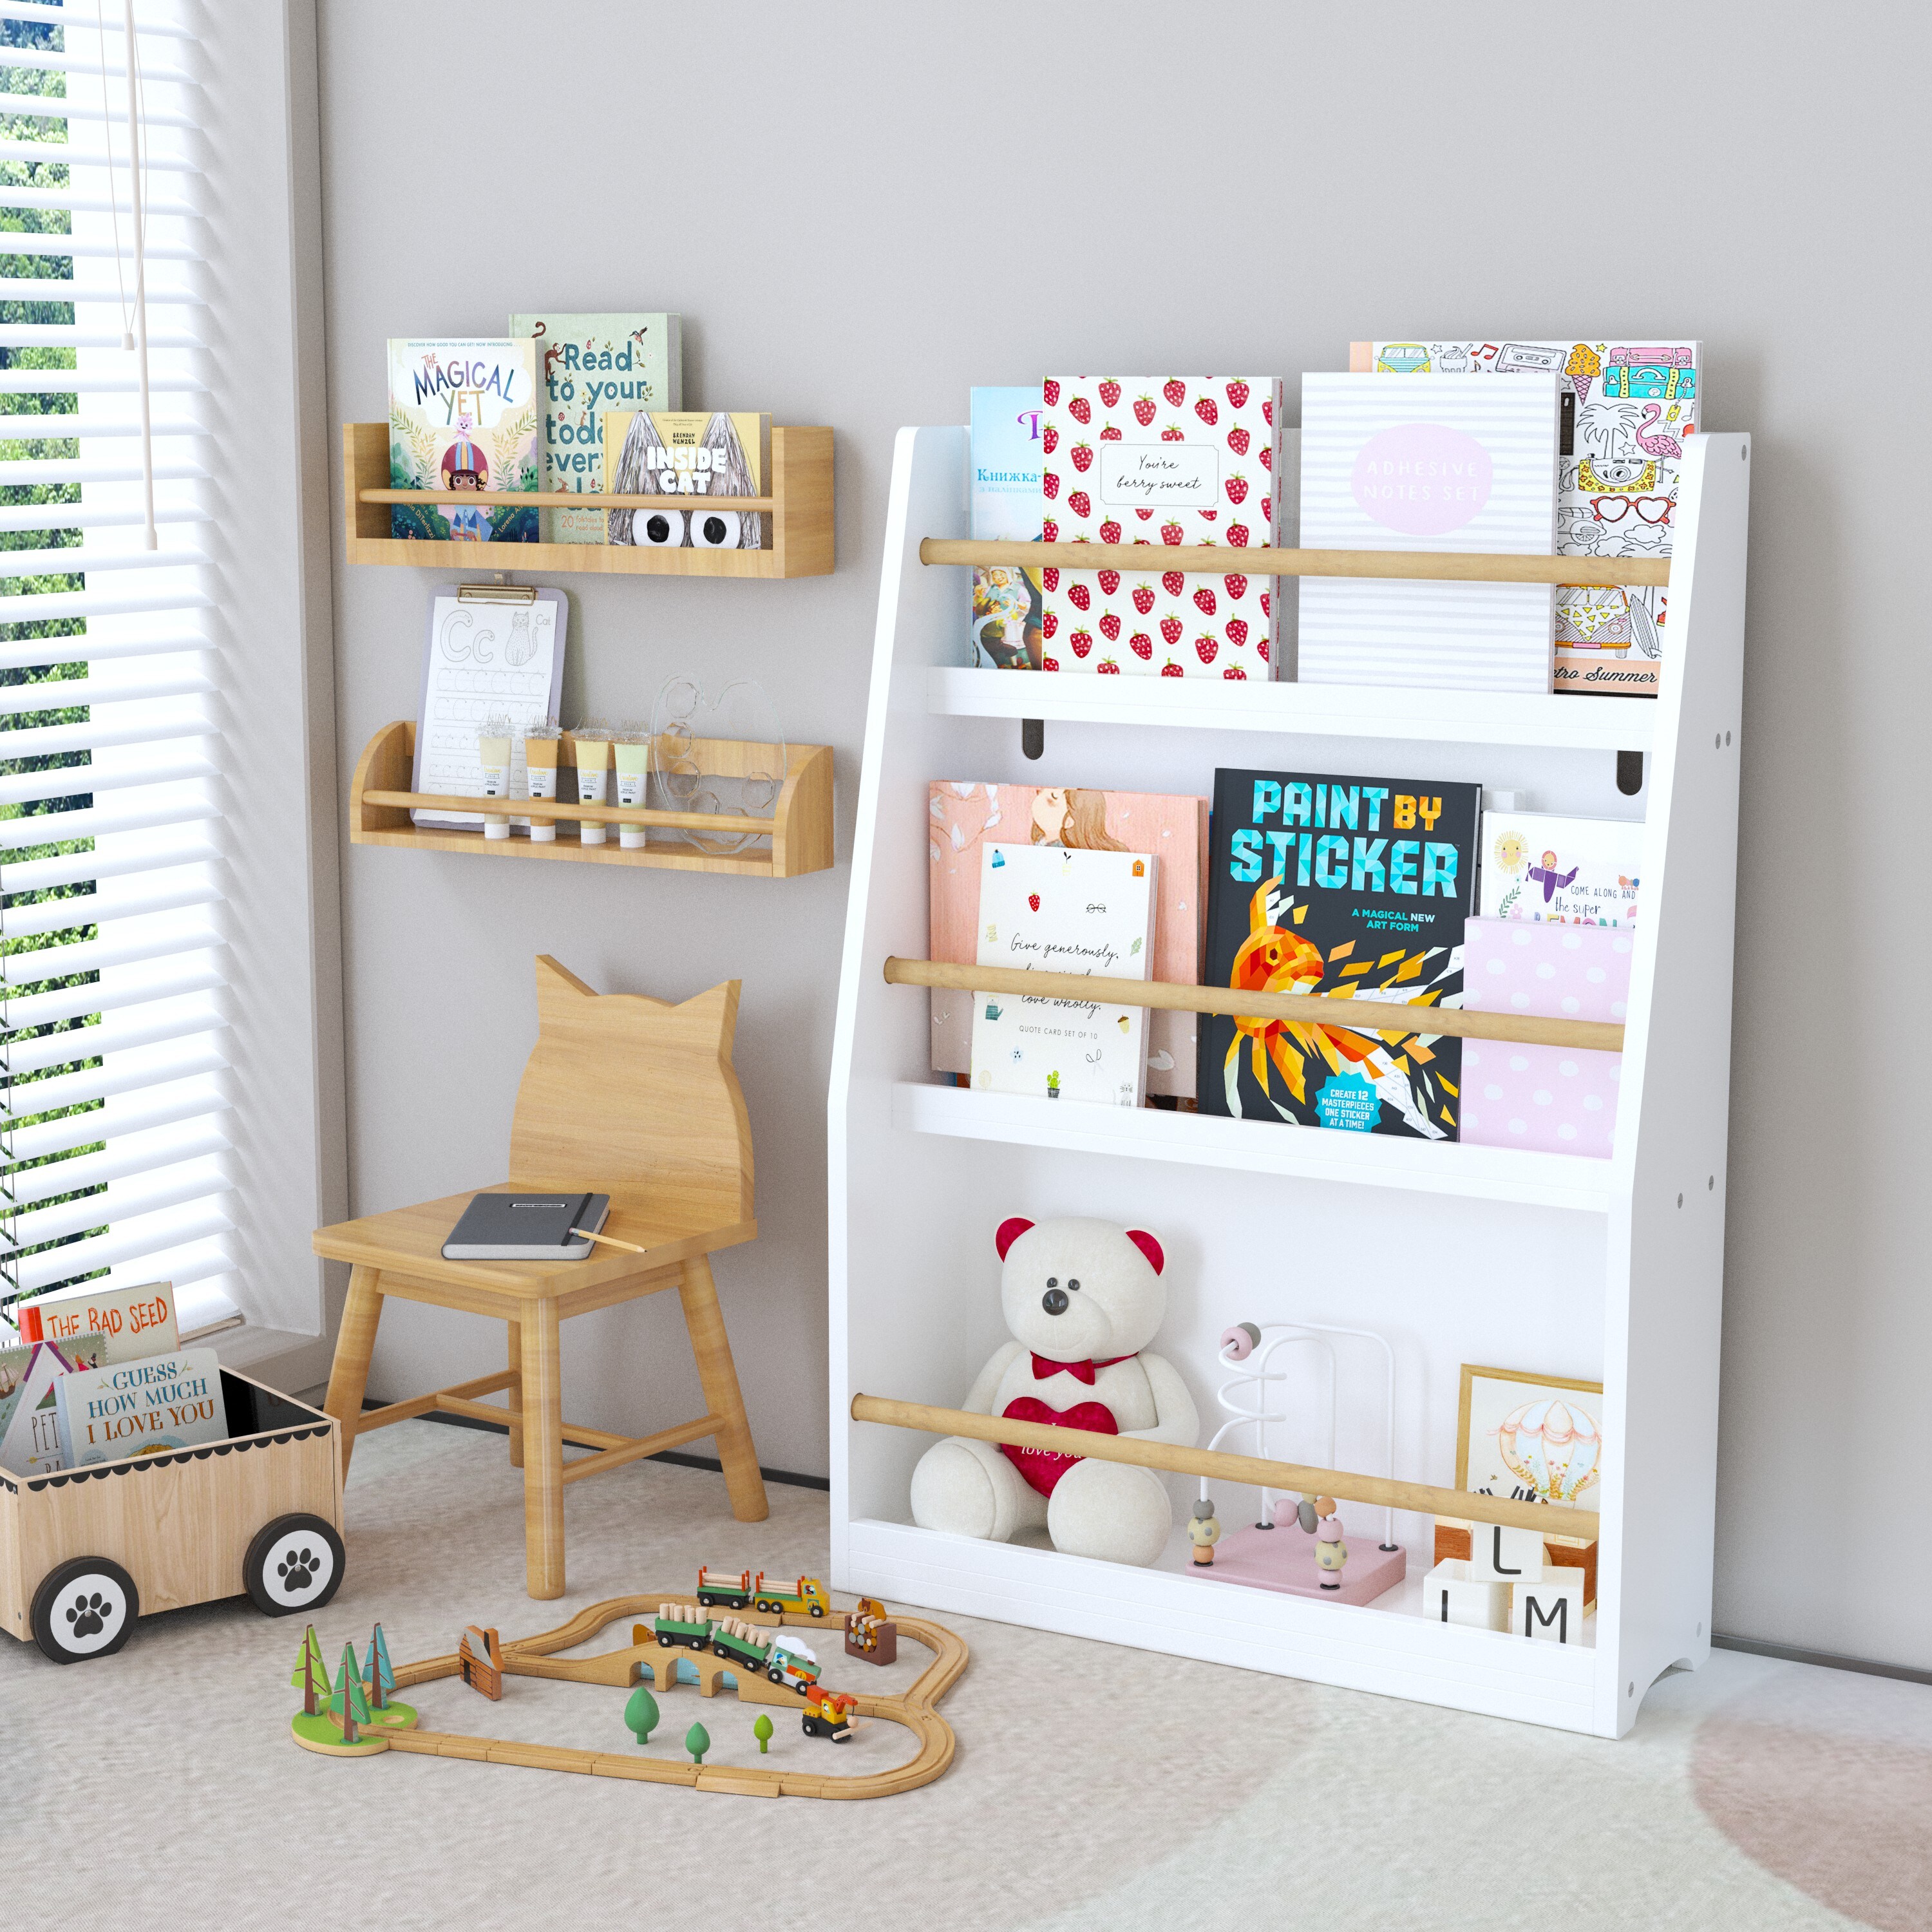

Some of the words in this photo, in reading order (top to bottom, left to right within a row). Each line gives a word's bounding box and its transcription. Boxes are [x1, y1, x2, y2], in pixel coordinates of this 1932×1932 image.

[421, 353, 438, 370] THE
[565, 341, 632, 372] Read
[413, 361, 514, 405] MAGICAL
[546, 375, 575, 402] to
[585, 381, 647, 410] your
[440, 390, 485, 426] YET
[647, 445, 726, 473] INSIDE
[1139, 454, 1179, 470] You're
[1367, 460, 1478, 477] ADHESIVE
[659, 469, 710, 493] CAT
[978, 469, 1041, 482] Книжка-
[1117, 475, 1158, 495] berry
[1160, 477, 1201, 489] sweet
[1363, 485, 1432, 501] NOTES
[1443, 486, 1481, 502] SET
[498, 513, 515, 533] Lorena
[562, 515, 574, 527] 20
[536, 614, 551, 625] Cat
[1583, 667, 1658, 683] Summer
[1252, 779, 1389, 832] PAINT
[1393, 794, 1443, 831] BY
[1229, 828, 1459, 898] STICKER
[1571, 886, 1589, 895] COME
[1594, 887, 1617, 899] ALONG
[1622, 890, 1636, 900] AND
[1352, 909, 1359, 917] A
[1362, 909, 1408, 921] MAGICAL
[1410, 913, 1435, 923] NEW
[1555, 896, 1569, 912] the
[1573, 904, 1601, 917] super
[1367, 920, 1387, 929] ART
[1390, 922, 1419, 932] FORM
[1010, 933, 1041, 951] Give
[1043, 943, 1119, 967] generously,
[1019, 1025, 1041, 1034] QUOTE
[1321, 1098, 1374, 1111] MASTERPIECES
[1331, 1089, 1356, 1099] CREATE
[1358, 1090, 1368, 1101] 12
[1325, 1108, 1340, 1117] ONE
[1341, 1110, 1370, 1121] STICKER
[1329, 1118, 1338, 1126] AT
[1345, 1119, 1365, 1130] TIME!
[129, 1296, 167, 1334] SEED
[113, 1361, 177, 1390] GUESS
[88, 1392, 137, 1419] HOW
[146, 1378, 208, 1407] MUCH
[86, 1424, 96, 1445] I
[104, 1411, 164, 1441] LOVE
[167, 1399, 214, 1426] YOU
[1493, 1526, 1521, 1575] L
[1525, 1595, 1567, 1643] M
